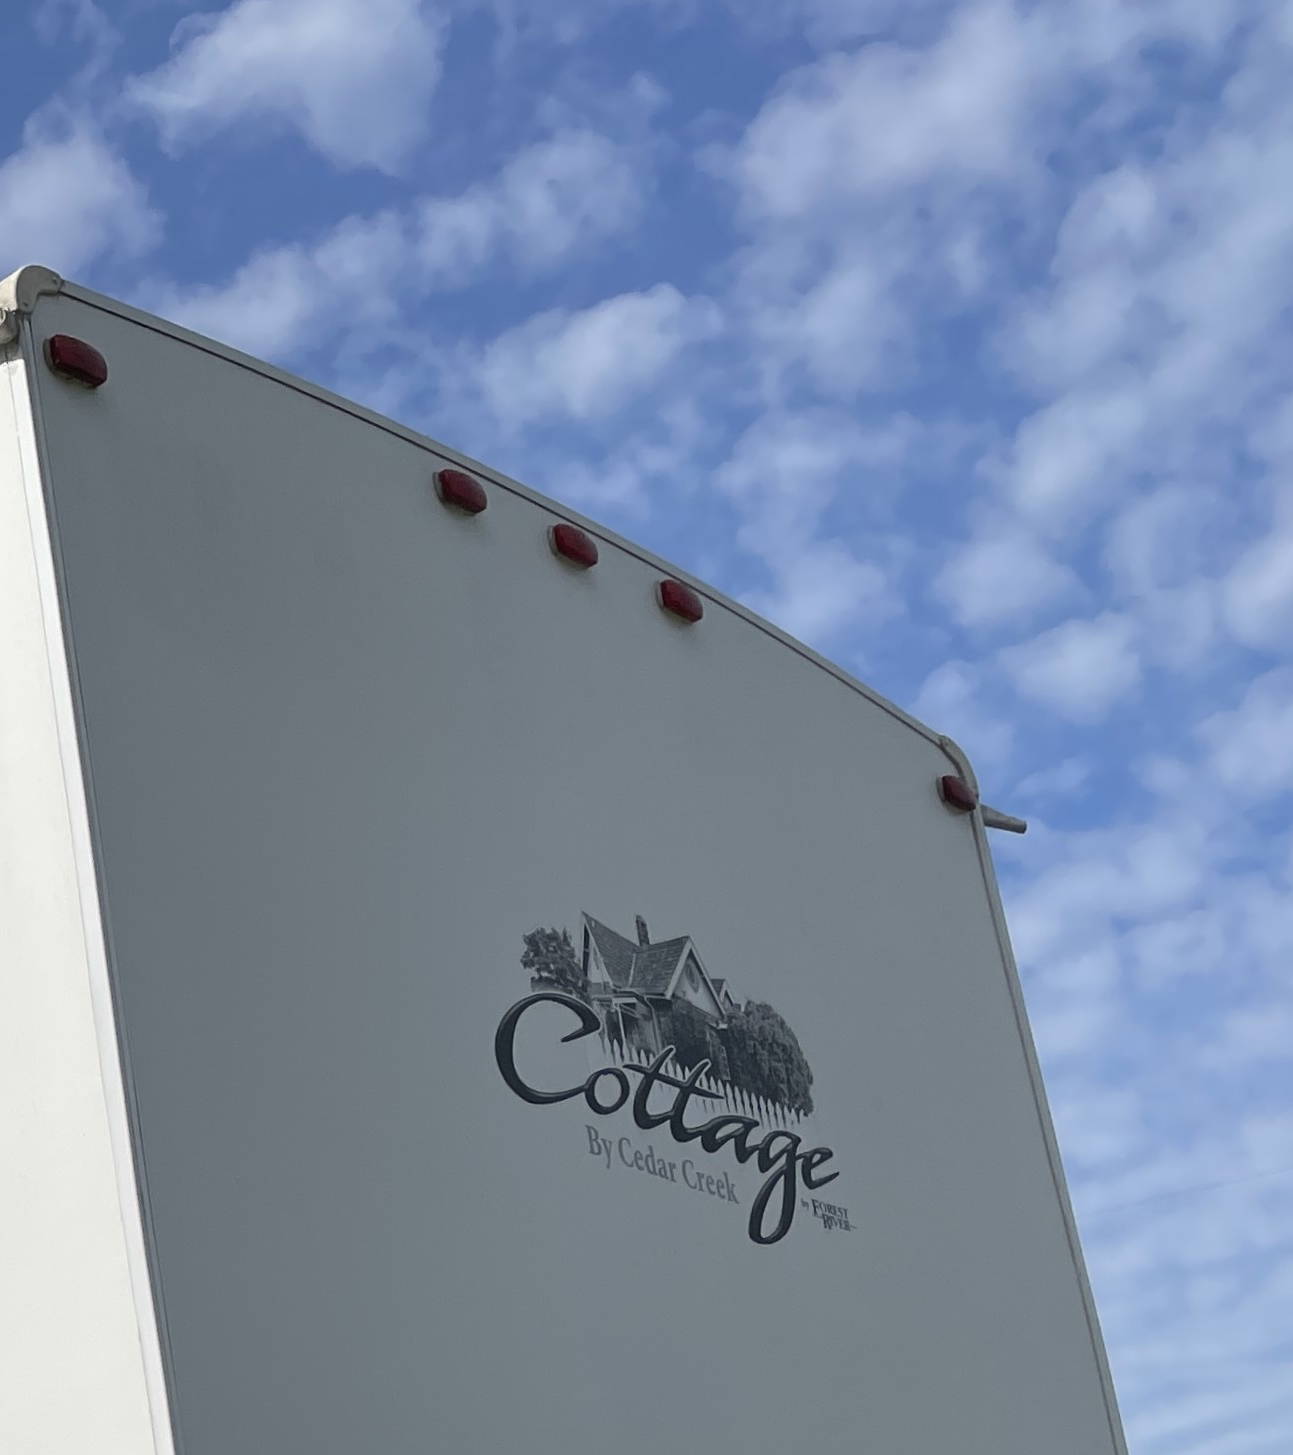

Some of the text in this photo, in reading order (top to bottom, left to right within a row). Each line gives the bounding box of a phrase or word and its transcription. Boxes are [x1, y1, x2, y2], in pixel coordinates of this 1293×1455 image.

[495, 992, 840, 1245] Cottage
[585, 1124, 739, 1204] By Cedar Creek
